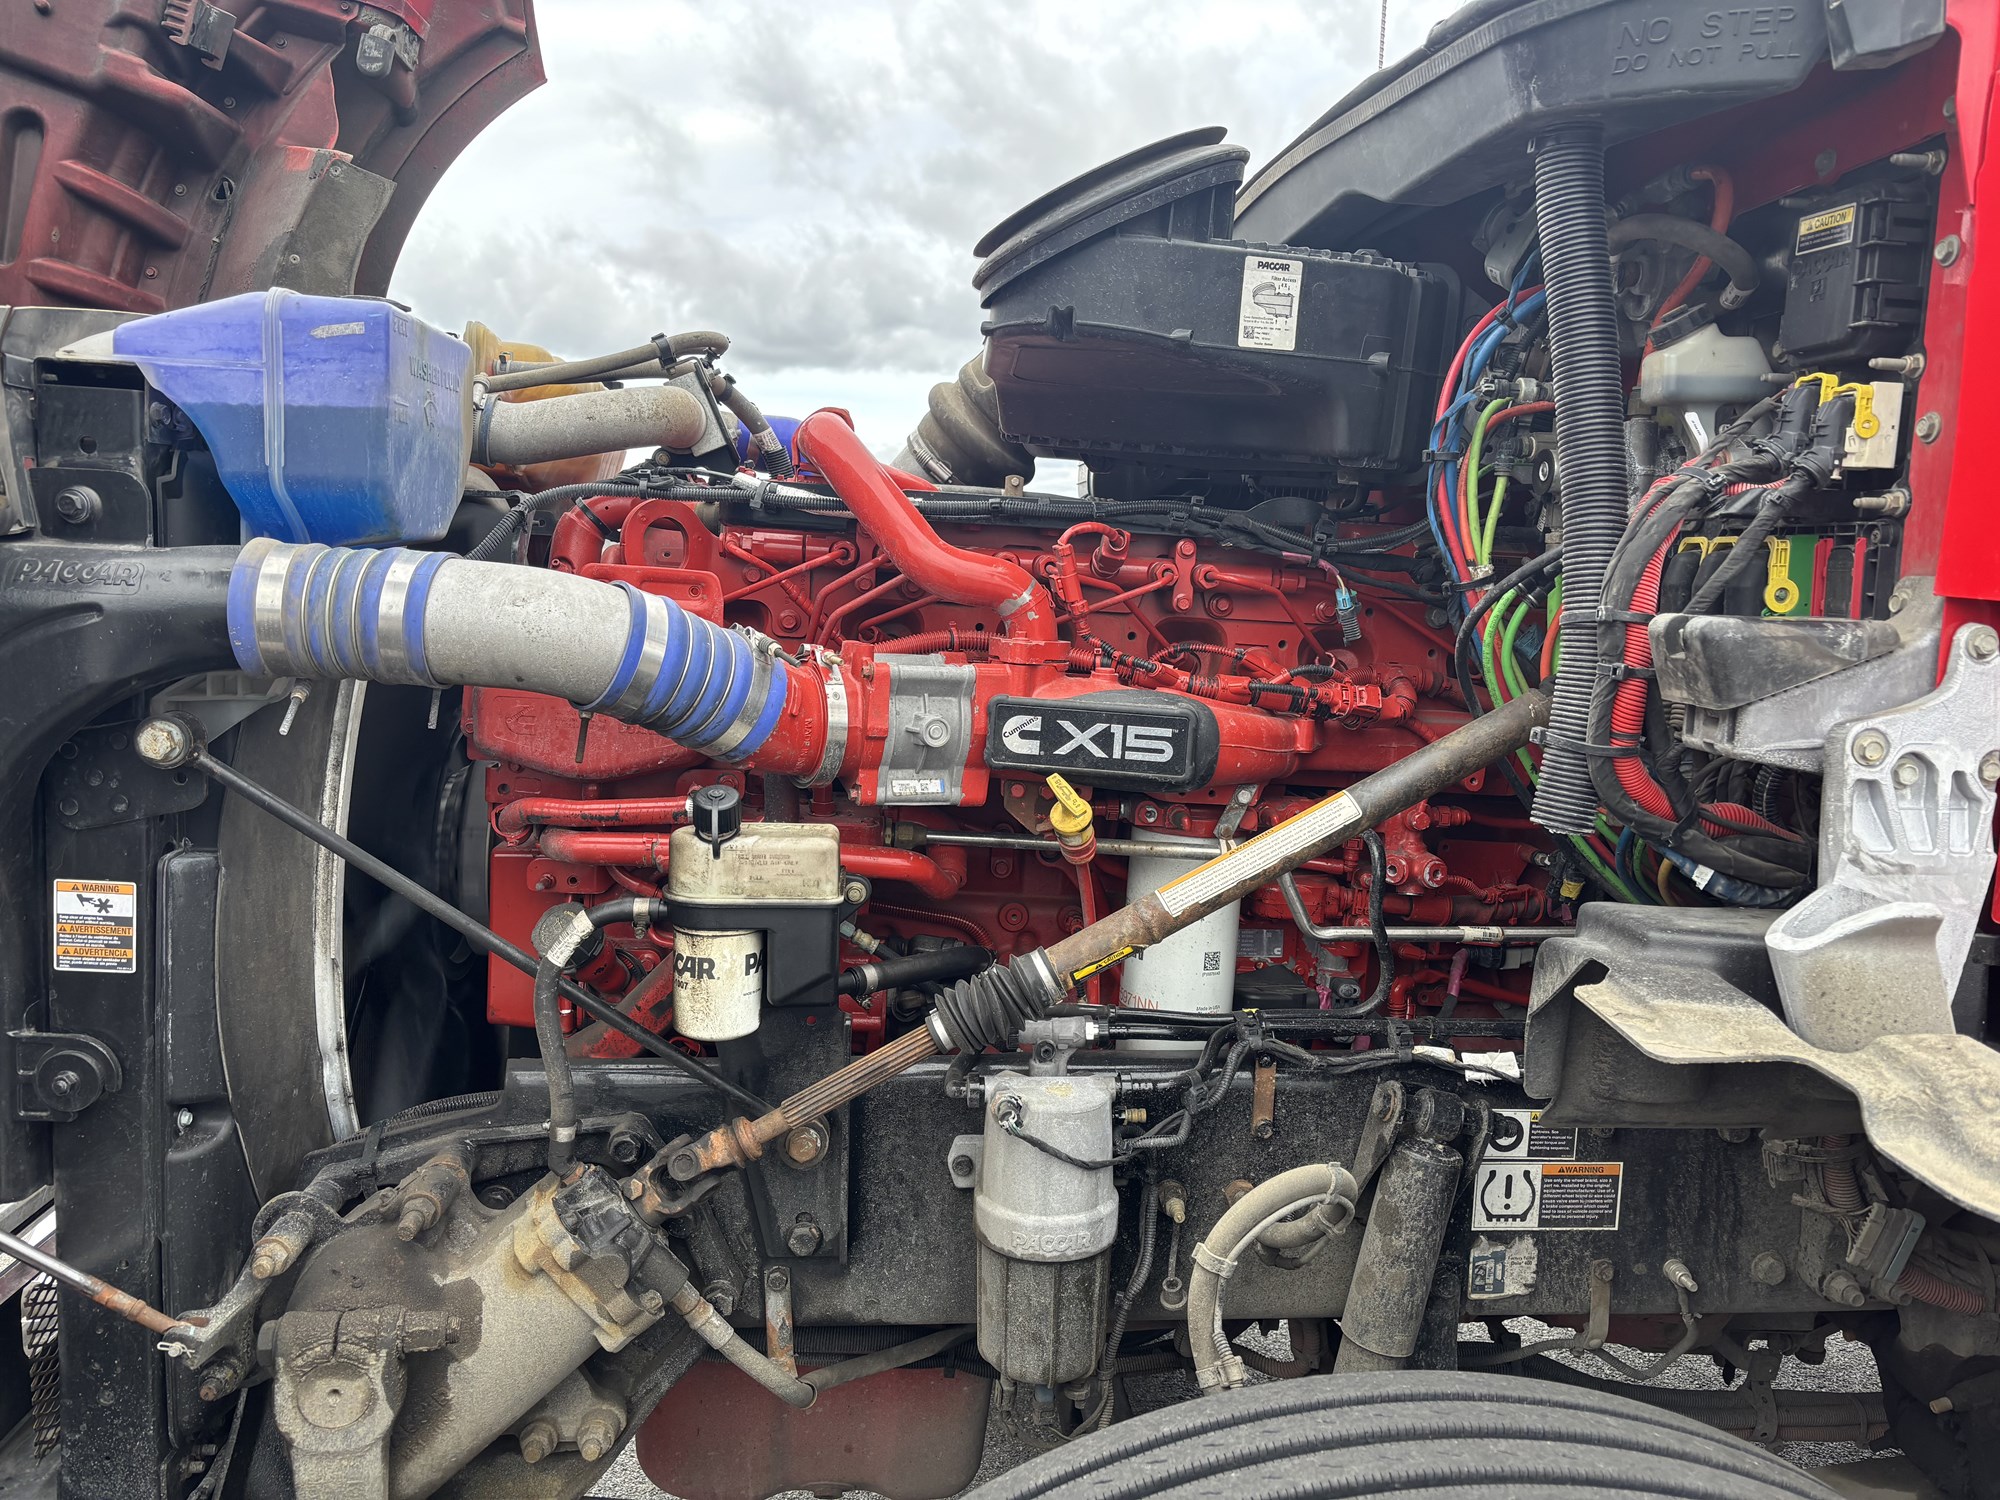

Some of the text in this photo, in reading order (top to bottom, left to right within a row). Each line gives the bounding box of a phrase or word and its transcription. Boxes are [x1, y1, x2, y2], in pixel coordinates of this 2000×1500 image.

[1617, 6, 1797, 49] NO STEP
[1611, 40, 1800, 75] DO NOT PULL
[1814, 211, 1847, 229] CAUTION
[1257, 261, 1290, 272] PACCAR
[409, 355, 441, 386] WASHER
[13, 558, 139, 587] PACCAR
[1003, 716, 1039, 738] Cummins
[1053, 719, 1174, 763] X15
[82, 884, 119, 892] WARNING
[69, 925, 132, 935] AVERTISSEMENT
[73, 947, 128, 957] ADVERTENCIA
[1104, 950, 1124, 964] CAUTION
[1011, 1231, 1091, 1253] PACCAR
